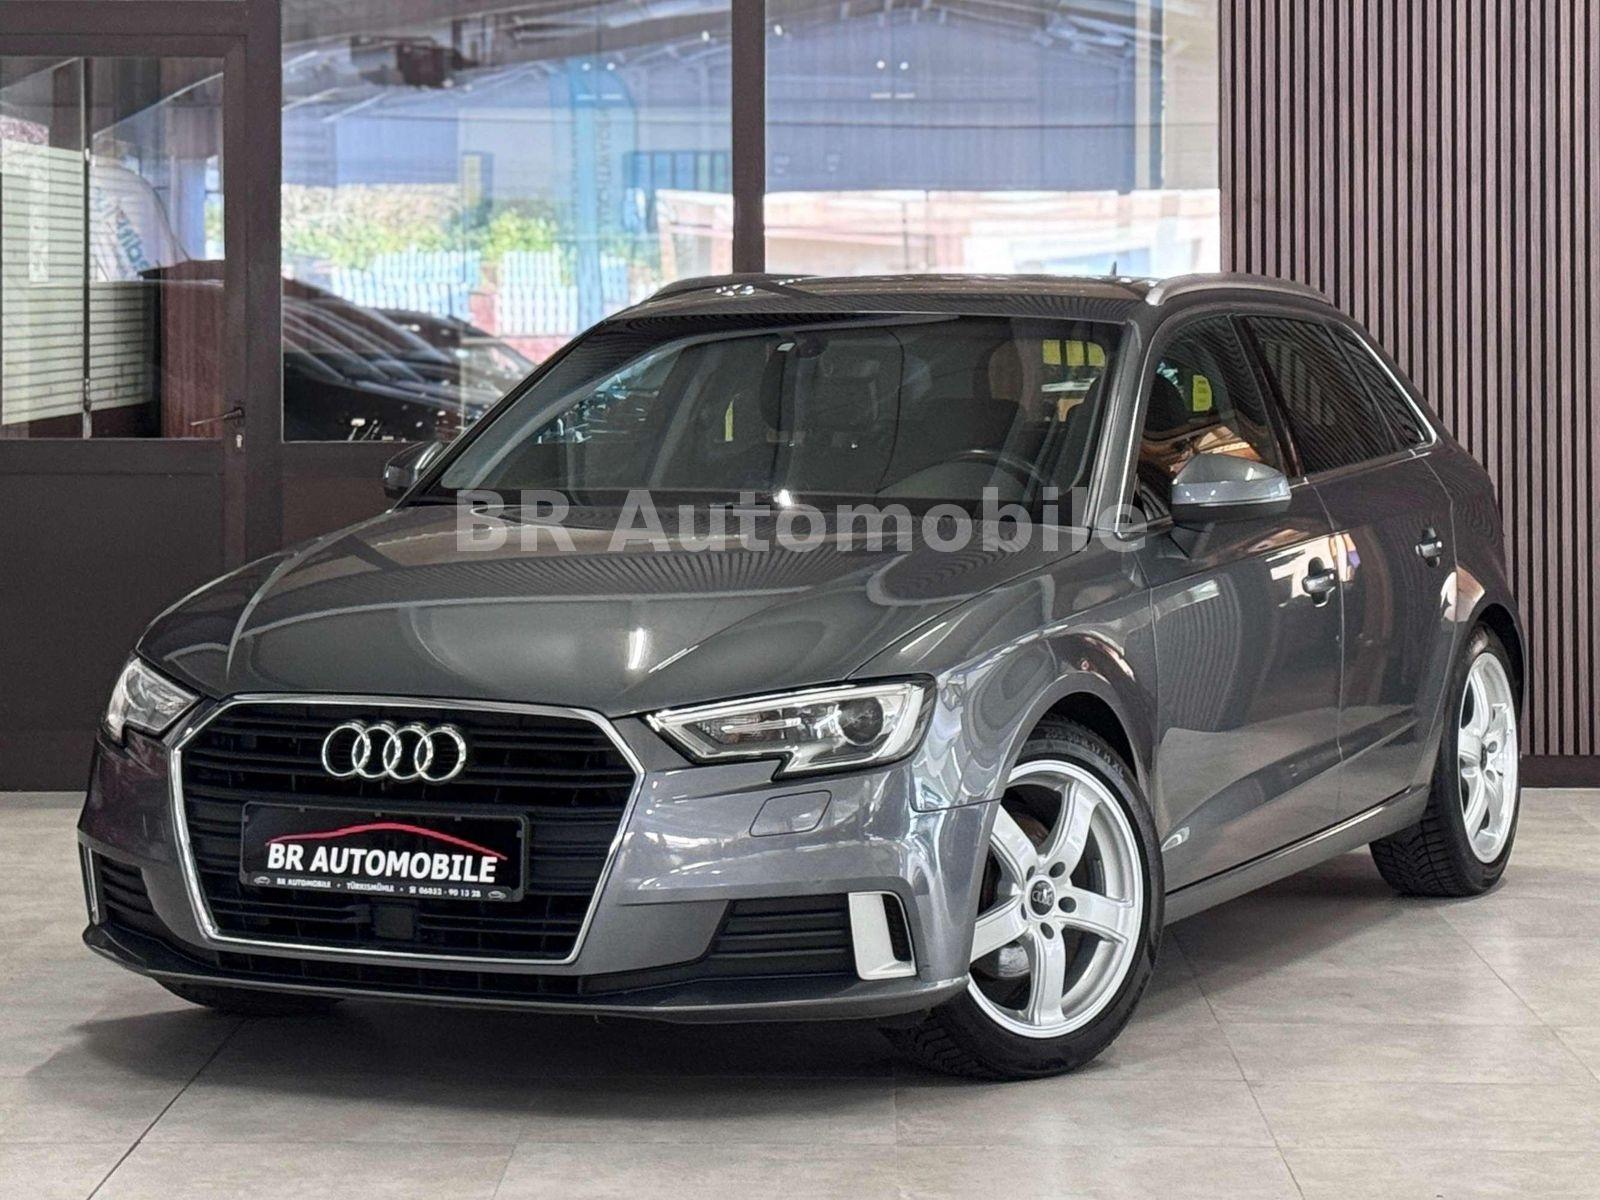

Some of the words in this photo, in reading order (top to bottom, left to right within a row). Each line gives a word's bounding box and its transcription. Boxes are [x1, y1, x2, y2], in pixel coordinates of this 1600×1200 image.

[267, 843, 304, 872] BR
[309, 846, 498, 883] AUTOMOBILE
[287, 879, 331, 888] AUTOMOBILE
